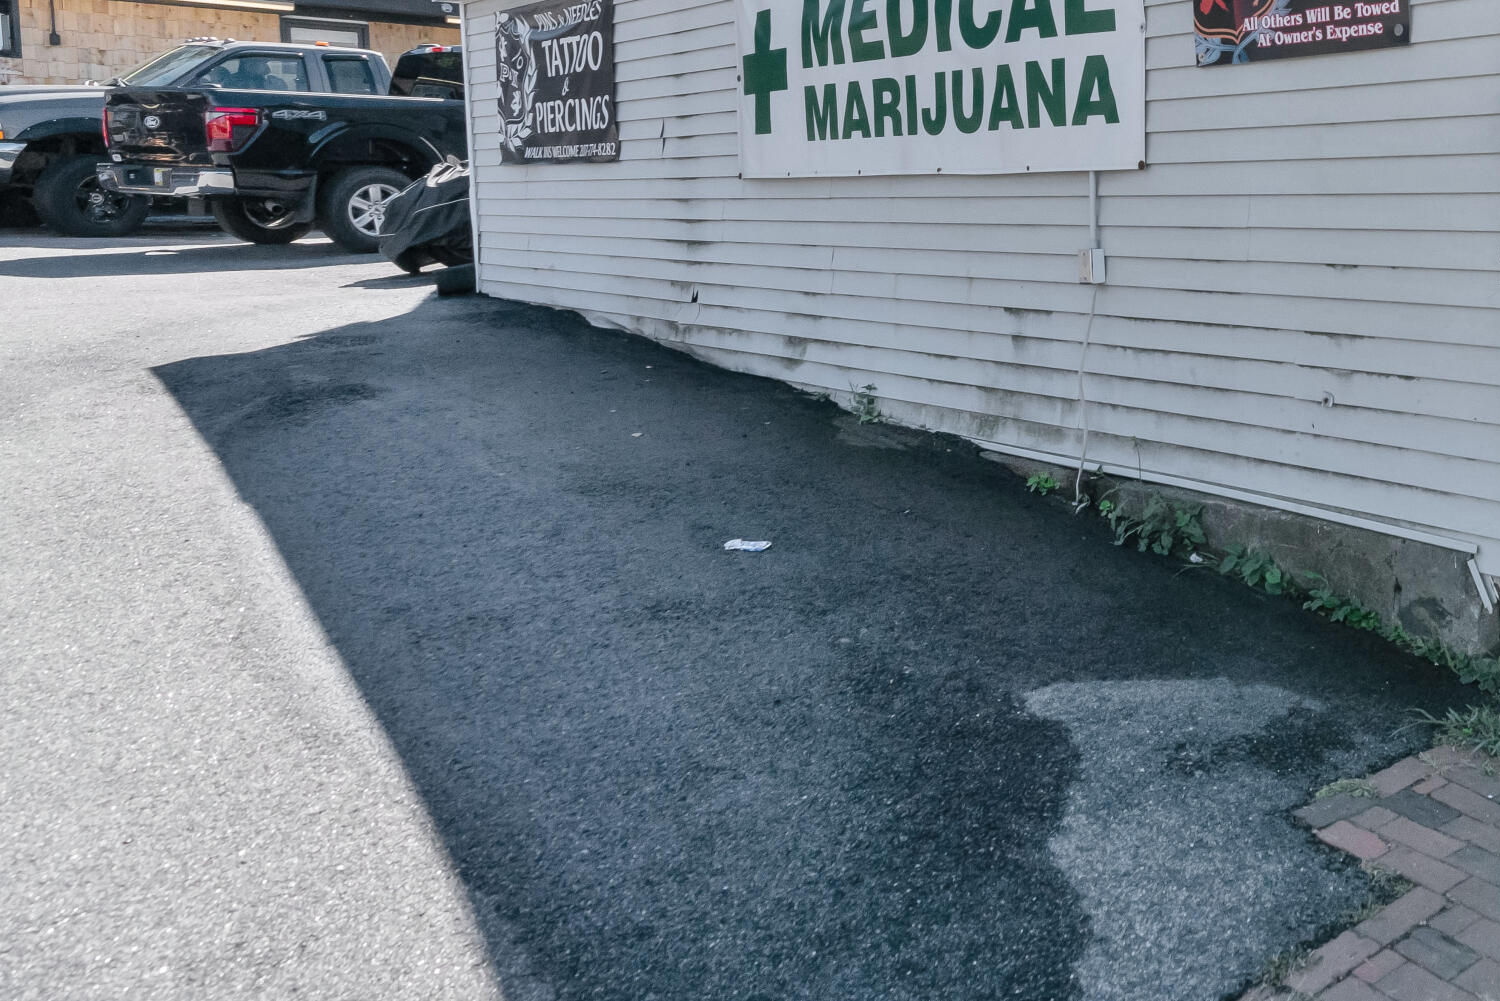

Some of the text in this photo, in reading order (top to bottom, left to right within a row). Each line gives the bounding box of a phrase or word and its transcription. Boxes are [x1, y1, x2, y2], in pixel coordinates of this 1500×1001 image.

[534, 11, 559, 33] PINS
[1242, 14, 1259, 32] All
[1261, 11, 1303, 31] Others
[1305, 6, 1330, 25] Will
[1333, 3, 1352, 20] Be
[1257, 20, 1384, 48] At Owner's Expense
[541, 31, 603, 78] TATTOO
[561, 76, 570, 97] &
[804, 55, 1121, 142] MARIJUANA
[535, 94, 610, 134] PIERCINGS
[524, 146, 543, 159] WALK
[552, 144, 579, 158] WELCOME
